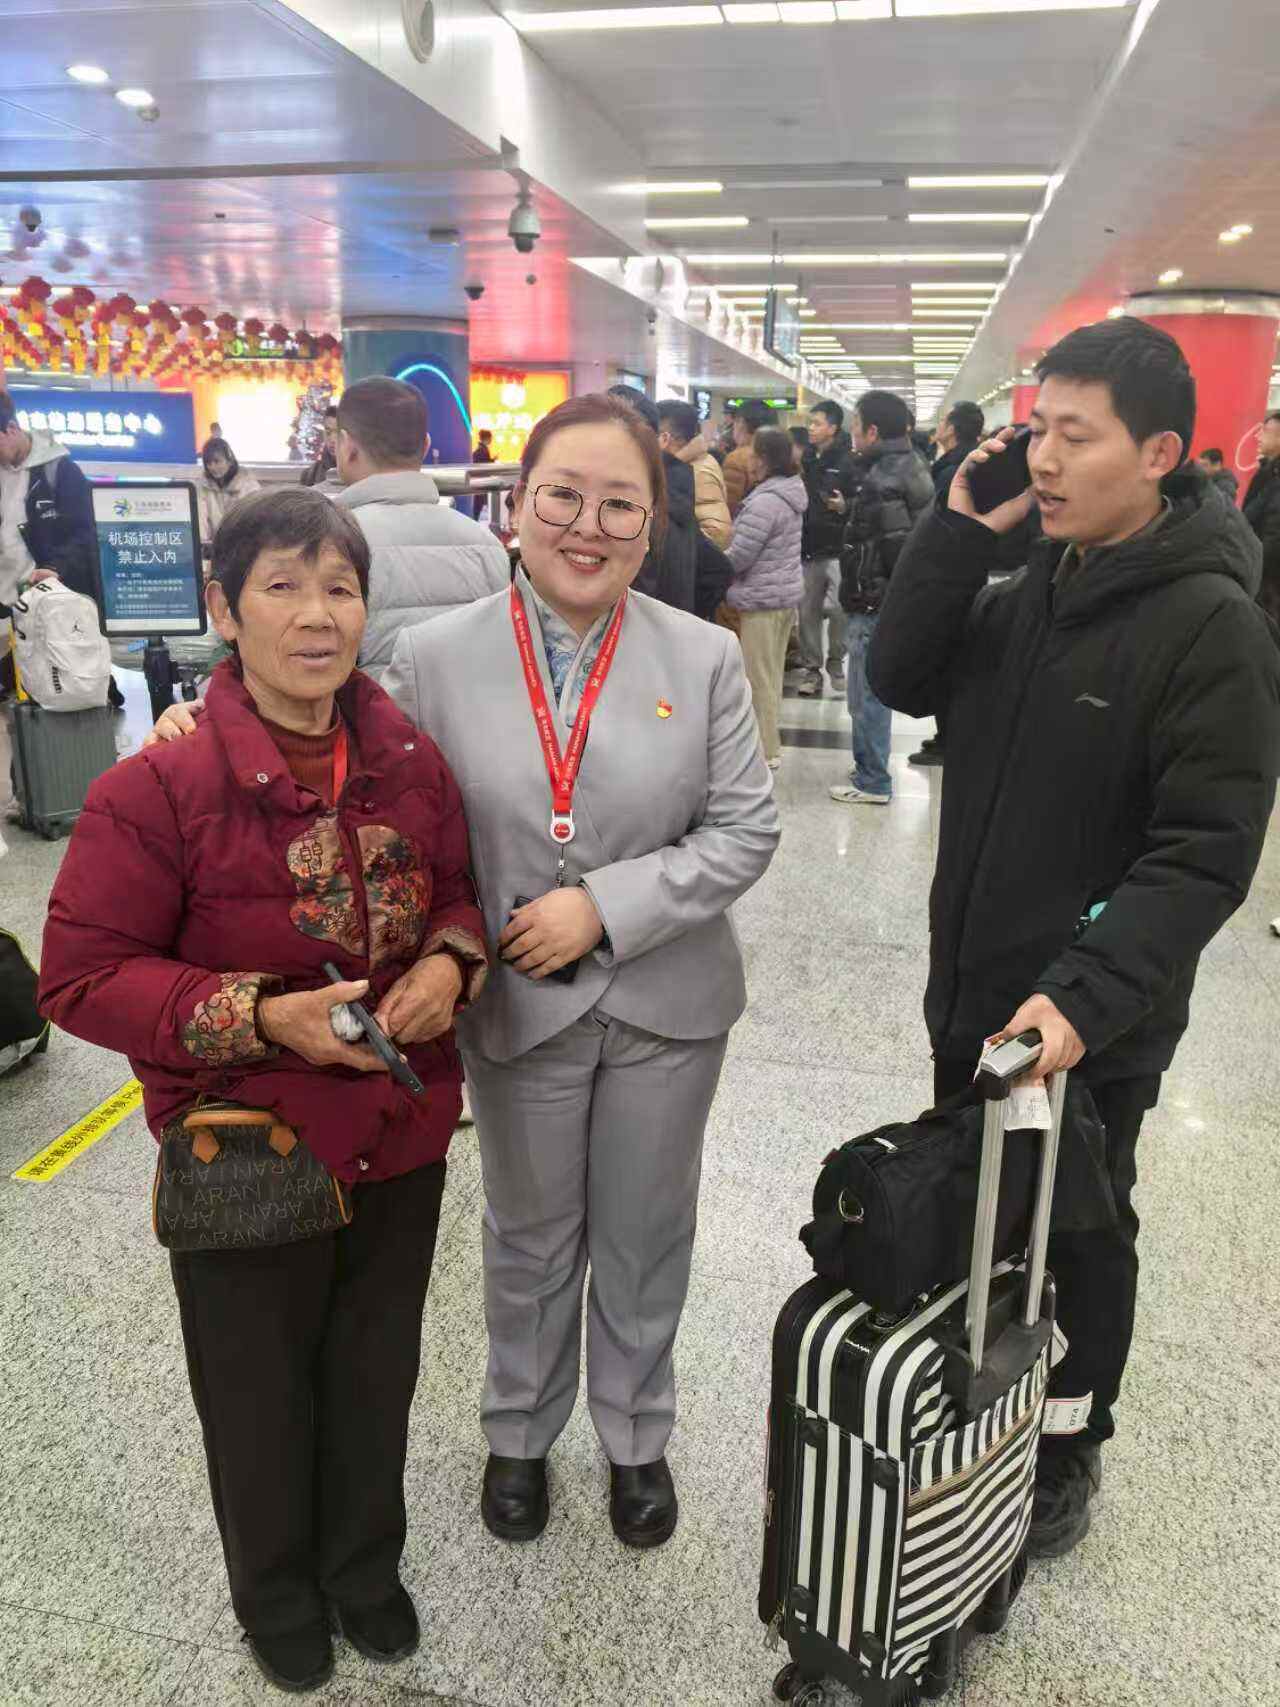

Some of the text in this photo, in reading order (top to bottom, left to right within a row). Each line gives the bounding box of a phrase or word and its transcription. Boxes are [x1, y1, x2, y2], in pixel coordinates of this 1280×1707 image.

[108, 531, 184, 546] 机场控制区
[117, 550, 177, 564] 禁止入内
[192, 1183, 262, 1207] ARAN
[239, 1200, 304, 1222] ARAN
[197, 1223, 267, 1246] ARAN
